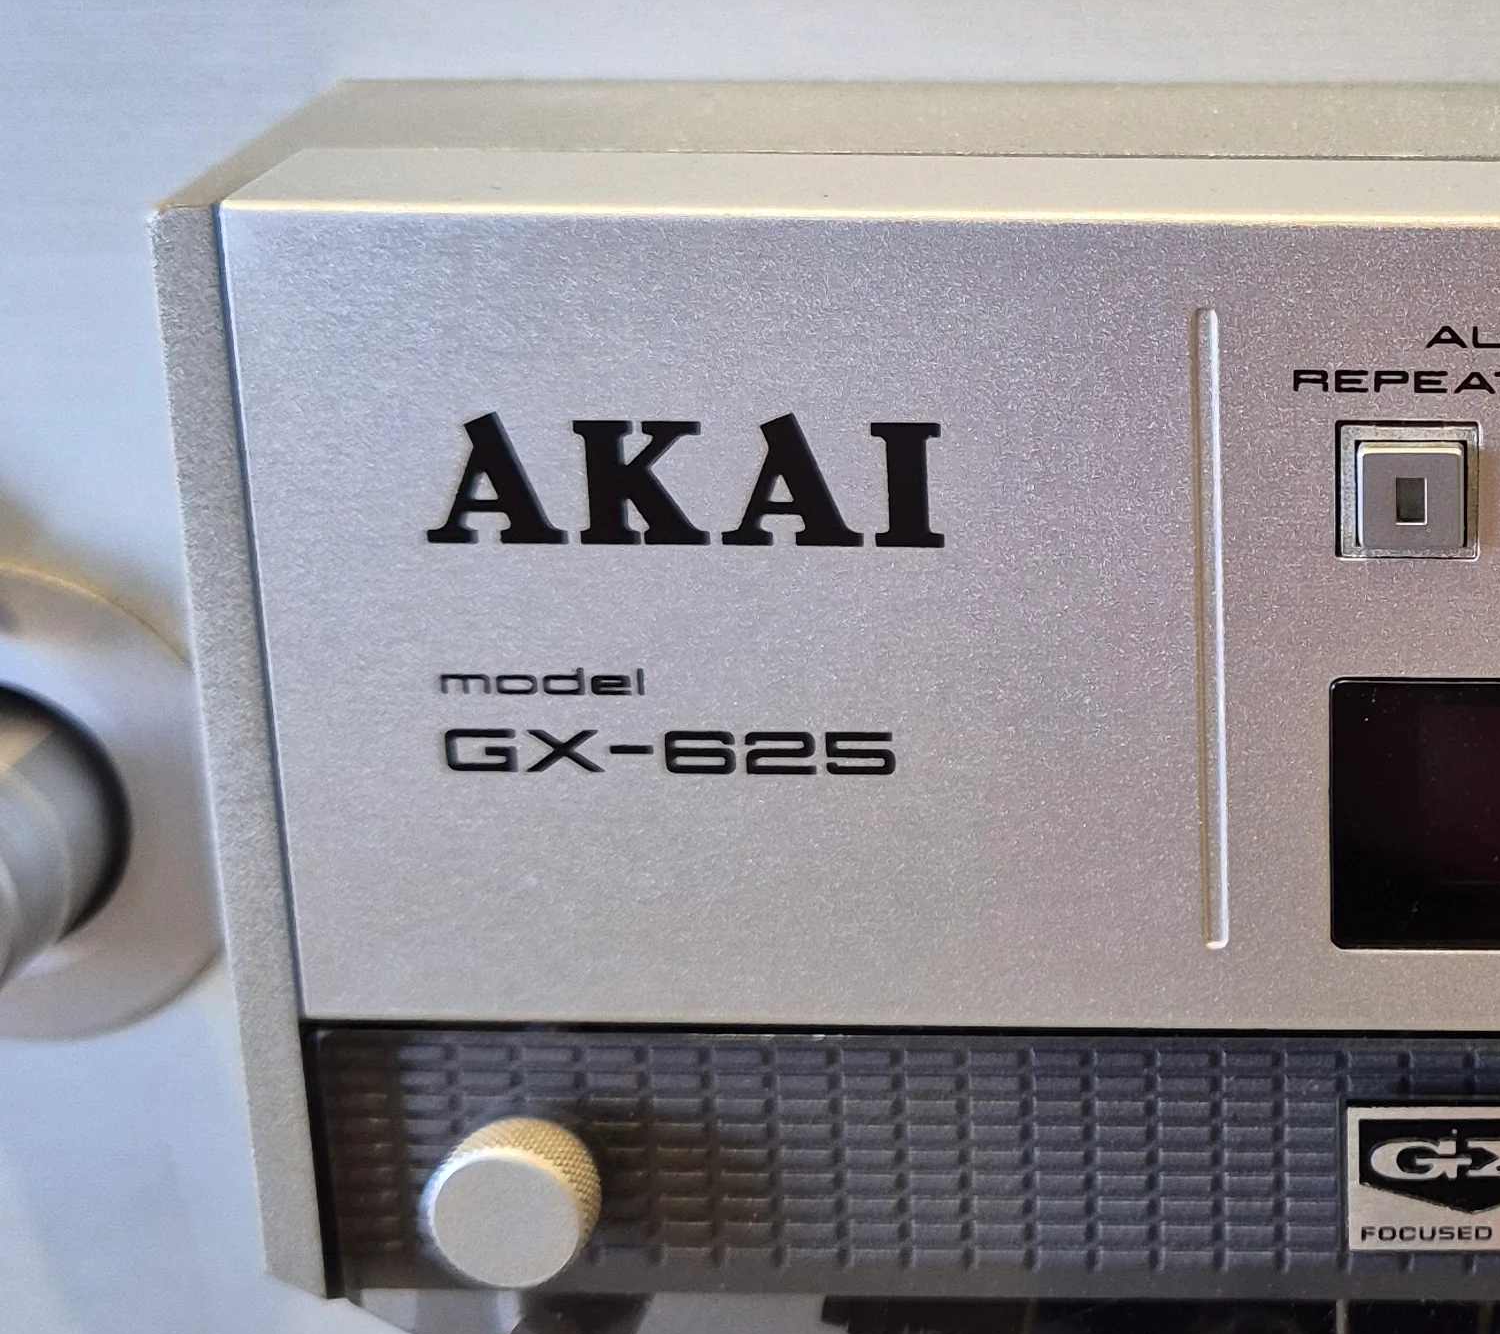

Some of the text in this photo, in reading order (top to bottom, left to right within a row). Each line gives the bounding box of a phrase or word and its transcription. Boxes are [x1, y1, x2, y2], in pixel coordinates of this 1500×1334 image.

[427, 411, 945, 548] AKAI
[439, 667, 645, 696] model
[444, 729, 896, 775] GX-625
[1360, 1225, 1493, 1242] FOCUSED
